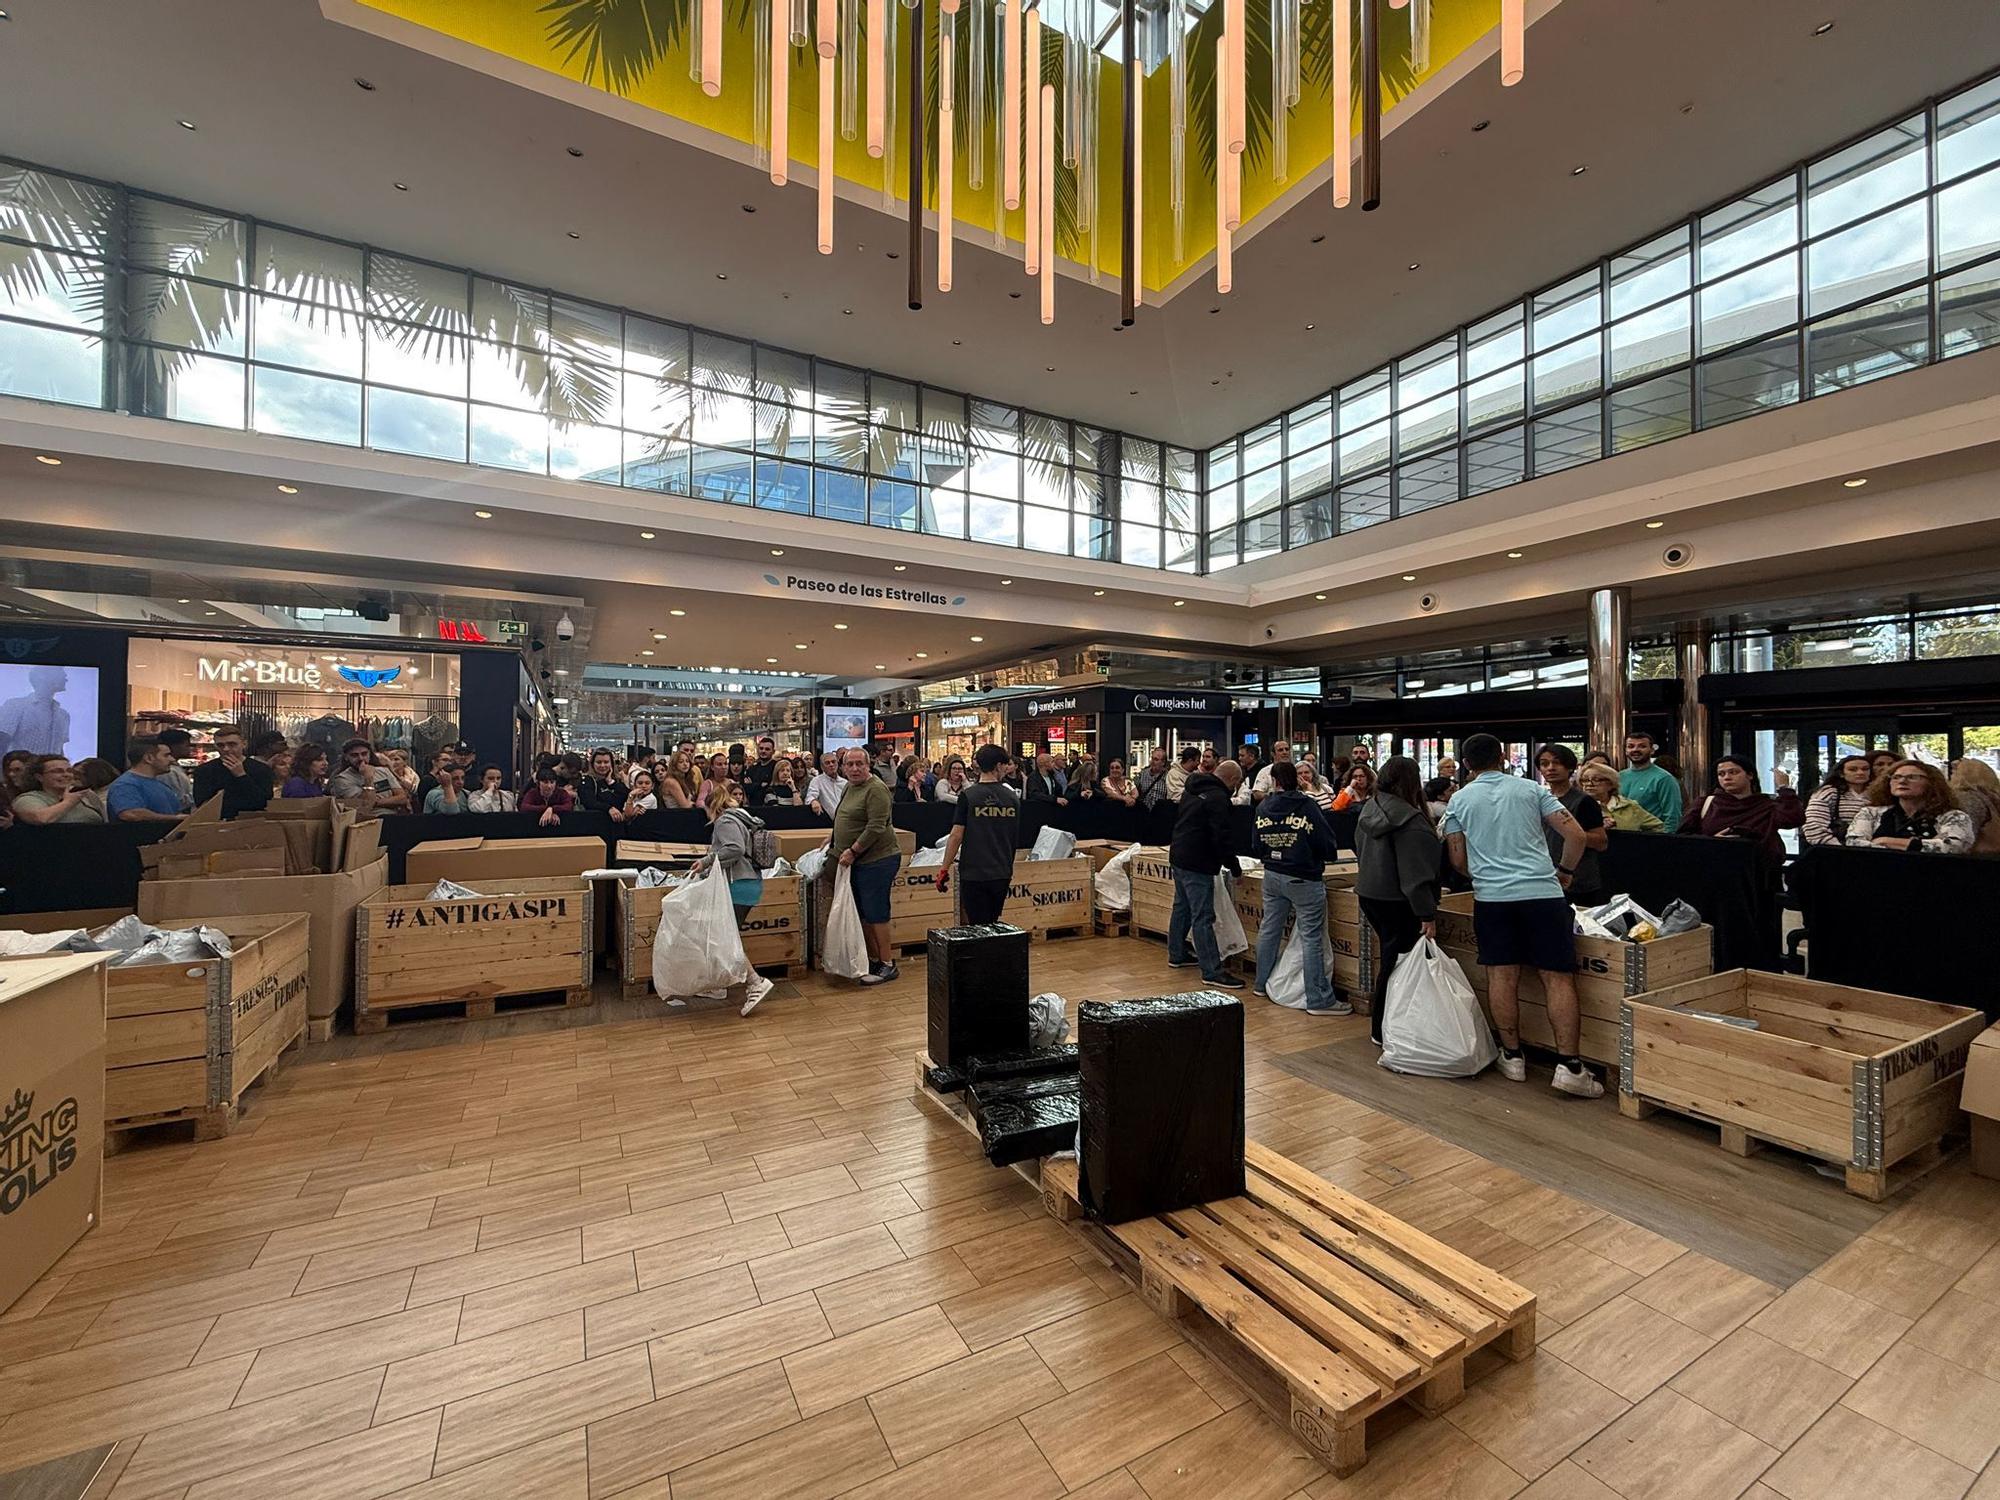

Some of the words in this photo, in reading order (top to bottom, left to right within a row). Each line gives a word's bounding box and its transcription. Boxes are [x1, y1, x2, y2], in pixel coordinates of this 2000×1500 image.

[787, 576, 836, 593] Paseo
[838, 582, 858, 595] de
[861, 584, 883, 598] las
[886, 587, 947, 605] Estrellas
[256, 661, 321, 684] Blue
[1038, 700, 1065, 713] sunglass
[1064, 697, 1076, 710] hut
[1150, 697, 1190, 712] sunglass
[1191, 697, 1206, 710] hut
[975, 806, 1016, 817] KING
[1032, 888, 1084, 906] SECRET
[385, 898, 567, 930] #ANTIGASPI
[236, 971, 280, 1018] TRESORS
[1882, 1035, 1939, 1083] TRESORS
